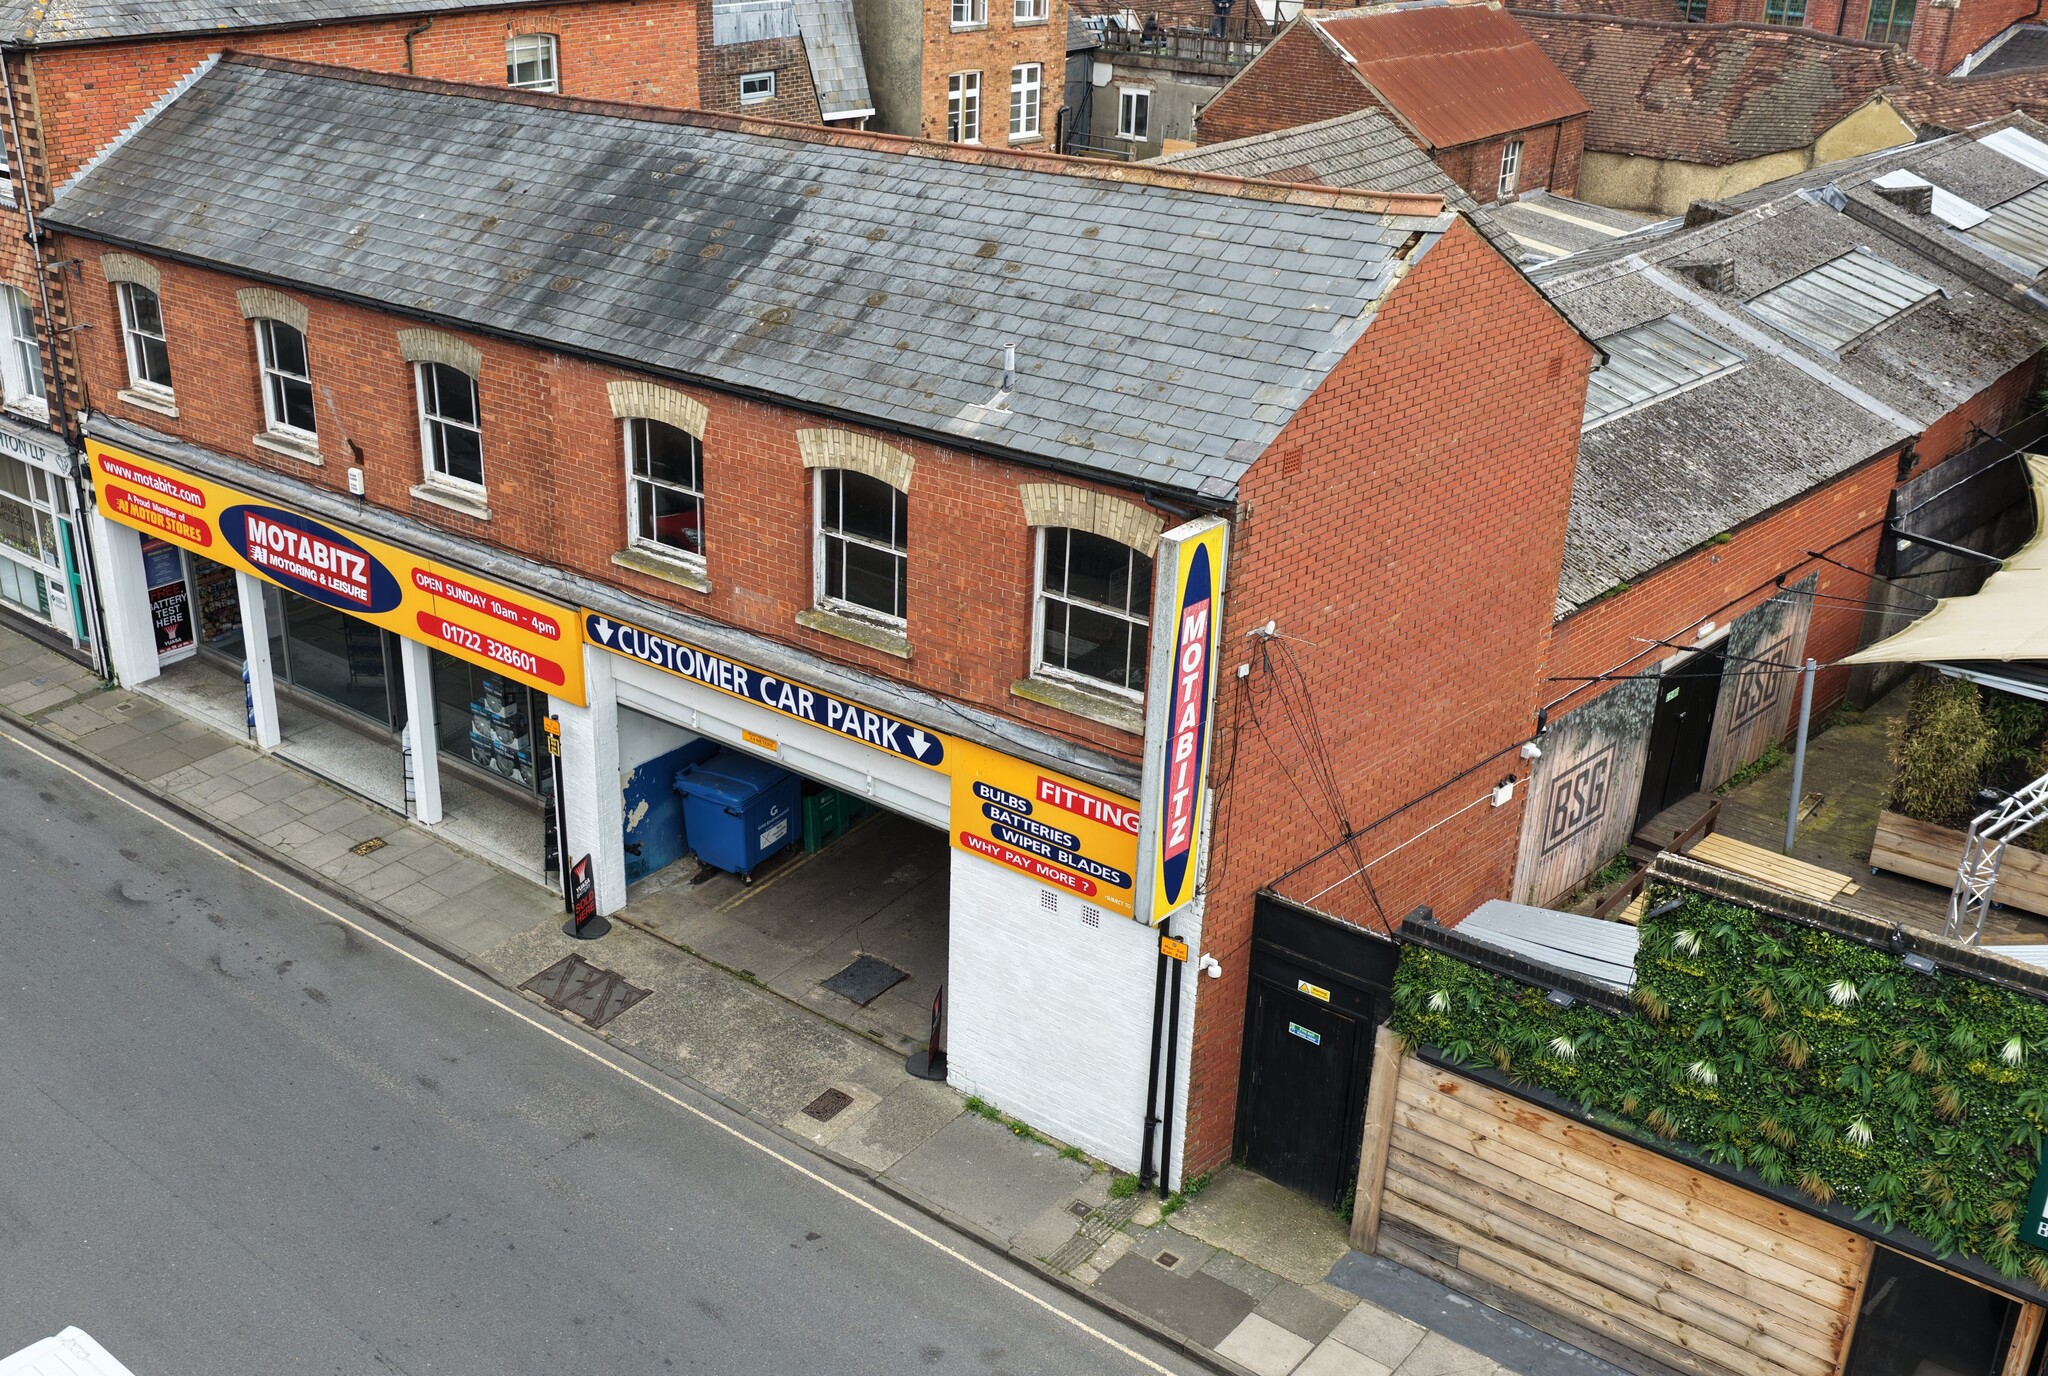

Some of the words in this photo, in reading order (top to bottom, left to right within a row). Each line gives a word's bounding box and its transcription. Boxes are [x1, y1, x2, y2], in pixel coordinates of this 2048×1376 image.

[29, 443, 46, 462] LLP
[103, 460, 201, 506] www.motabitz.com
[127, 493, 132, 502] A
[133, 496, 151, 508] Proud
[152, 502, 177, 519] Member
[178, 513, 186, 522] of
[130, 504, 165, 527] MOTOR
[166, 516, 202, 542] STORES
[247, 516, 367, 584] MOTABITZ
[269, 553, 318, 582] MOTORING
[319, 573, 327, 586] &
[328, 576, 367, 601] LEISURE
[156, 604, 181, 619] TEST
[156, 613, 184, 628] HERE
[416, 573, 443, 593] OPEN
[446, 583, 486, 609] SUNDAY
[490, 601, 518, 622] 10am
[531, 616, 556, 636] 4pm
[442, 621, 482, 652] 01722
[487, 639, 537, 674] 328601
[617, 625, 749, 697] CUSTOMER
[759, 676, 816, 722] CAR
[827, 698, 902, 753] PARK
[1735, 649, 1784, 722] BSG
[1169, 614, 1208, 849] MOTABITZ
[770, 805, 778, 816] G
[980, 784, 1027, 812] BULBS
[1041, 780, 1140, 833] FITTING
[1550, 757, 1608, 841] BSG
[990, 806, 1072, 847] BATTERIES
[968, 836, 1000, 856] WHY
[1005, 851, 1031, 868] PAY
[1036, 864, 1076, 887] MORE
[1081, 881, 1090, 892] ?
[1002, 828, 1052, 857] WIPER
[1058, 849, 1121, 884] BLADES
[575, 890, 594, 914] SOLD
[575, 901, 595, 925] HERE
